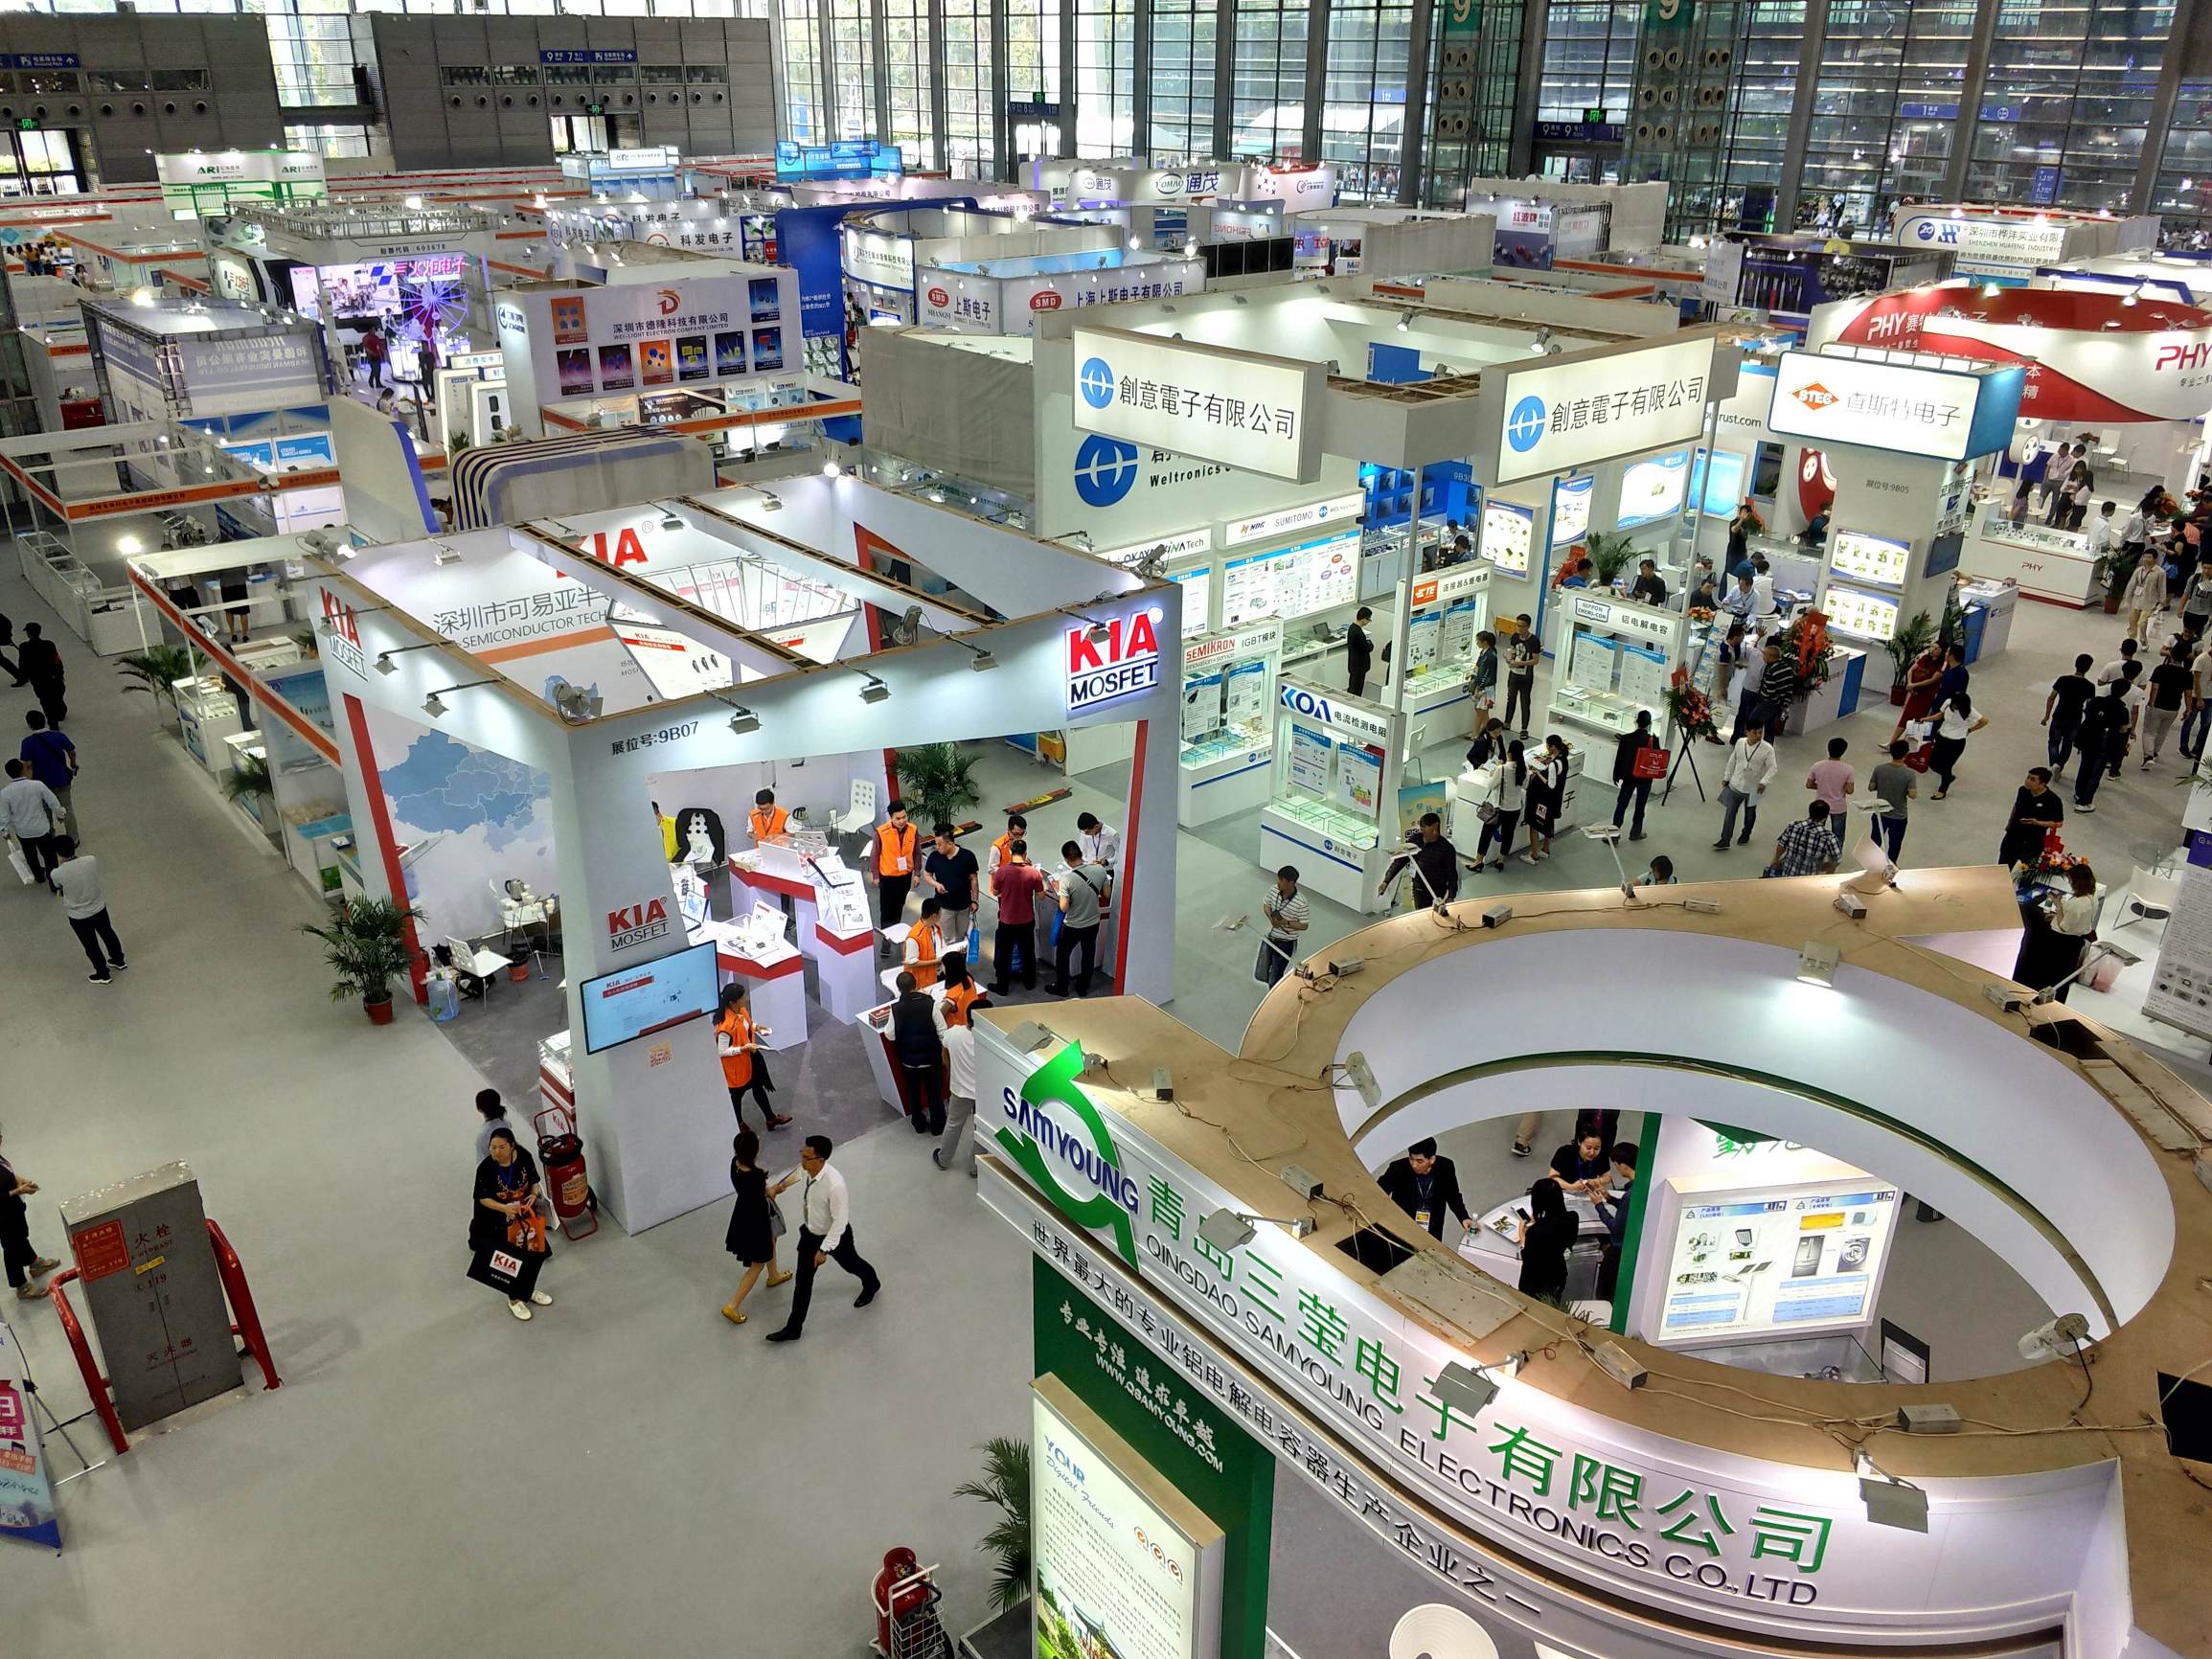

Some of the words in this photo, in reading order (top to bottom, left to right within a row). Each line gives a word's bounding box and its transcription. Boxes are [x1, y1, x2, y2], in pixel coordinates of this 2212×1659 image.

[1185, 171, 1220, 193] 通茂
[565, 226, 591, 239] 科发电子
[680, 232, 734, 247] 科发电子
[613, 312, 728, 334] 深圳市德隆科技有限公司
[954, 295, 991, 322] 上斯电子
[676, 325, 706, 333] COMPANY
[1867, 311, 1907, 341] PHY
[2155, 343, 2212, 371] PHY
[1119, 375, 1295, 441] 創意電子有限公司
[1549, 376, 1704, 435] 創意電子有限公司
[1150, 465, 1221, 488] Weltronics
[1274, 511, 1313, 528] SUMITOMO
[2021, 561, 2043, 572] PHY
[320, 585, 362, 649] KIA
[432, 584, 612, 634] 深圳市可易亚半
[1583, 602, 1604, 613] NIPPON
[461, 618, 576, 649] SEMICONDUCTOR
[1070, 613, 1158, 674] KIA
[1186, 639, 1236, 661] SEMIKRON
[1070, 662, 1158, 704] MOSFET
[1281, 685, 1333, 723] KOA
[611, 720, 699, 756] 展位号:9B07
[1334, 711, 1387, 738] 电流检测电阻
[607, 898, 667, 936] KIA
[611, 922, 668, 950] MOSFET
[1003, 1086, 1141, 1216] SAMYOUNG
[494, 1254, 517, 1272] KIA
[1147, 1233, 1239, 1319] QINGDAO
[1244, 1310, 1385, 1432] SAMYOUNG
[1400, 1426, 1651, 1568] ELECTRONICS
[1032, 1218, 1541, 1615] 世界最大的专业铝电解电容器生产企业之一
[1044, 1435, 1085, 1486] YOUR
[1046, 1454, 1078, 1491] Digital
[1082, 1490, 1114, 1529] Friends
